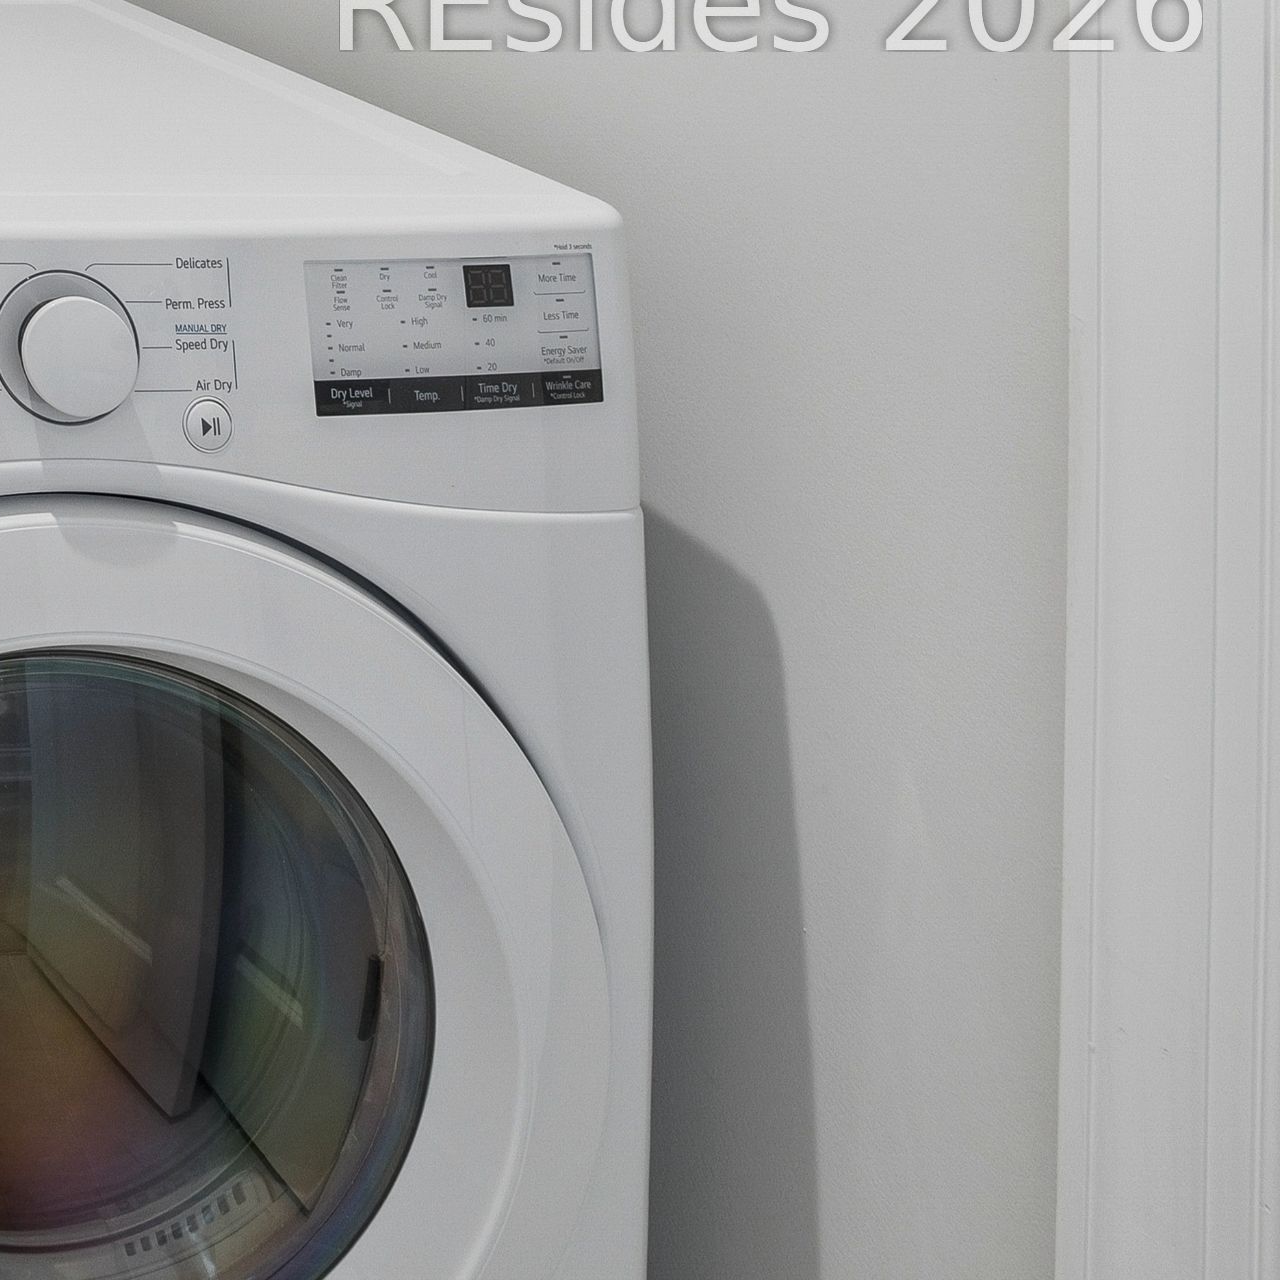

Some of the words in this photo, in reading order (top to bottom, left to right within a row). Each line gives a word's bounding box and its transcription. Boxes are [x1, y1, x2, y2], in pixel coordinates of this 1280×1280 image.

[176, 258, 223, 269] Delicates
[538, 274, 557, 282] More
[559, 274, 576, 282] Time
[165, 298, 194, 310] Perm.
[197, 297, 225, 309] Press
[483, 314, 492, 322] 60
[494, 314, 507, 322] min
[544, 312, 560, 320] Less
[562, 311, 579, 319] Time
[337, 320, 353, 329] Very
[411, 318, 428, 327] High
[175, 324, 208, 333] MANUAL
[211, 324, 227, 333] DRY
[176, 338, 206, 351] Speed
[210, 338, 228, 352] Dry
[414, 341, 441, 349] Medium
[486, 339, 495, 347] 40
[339, 344, 365, 352] Normal
[542, 347, 565, 356] Energy
[568, 346, 587, 354] Saver
[488, 363, 497, 371] 20
[341, 368, 362, 378] Damp
[196, 379, 211, 391] Air
[213, 379, 232, 392] Dry
[478, 383, 499, 393] Time
[502, 383, 518, 394] Dry
[546, 382, 573, 390] Wrinkle
[575, 380, 591, 389] Care
[331, 388, 347, 400] Dry
[350, 388, 372, 398] Level
[414, 390, 440, 402] Temp.
